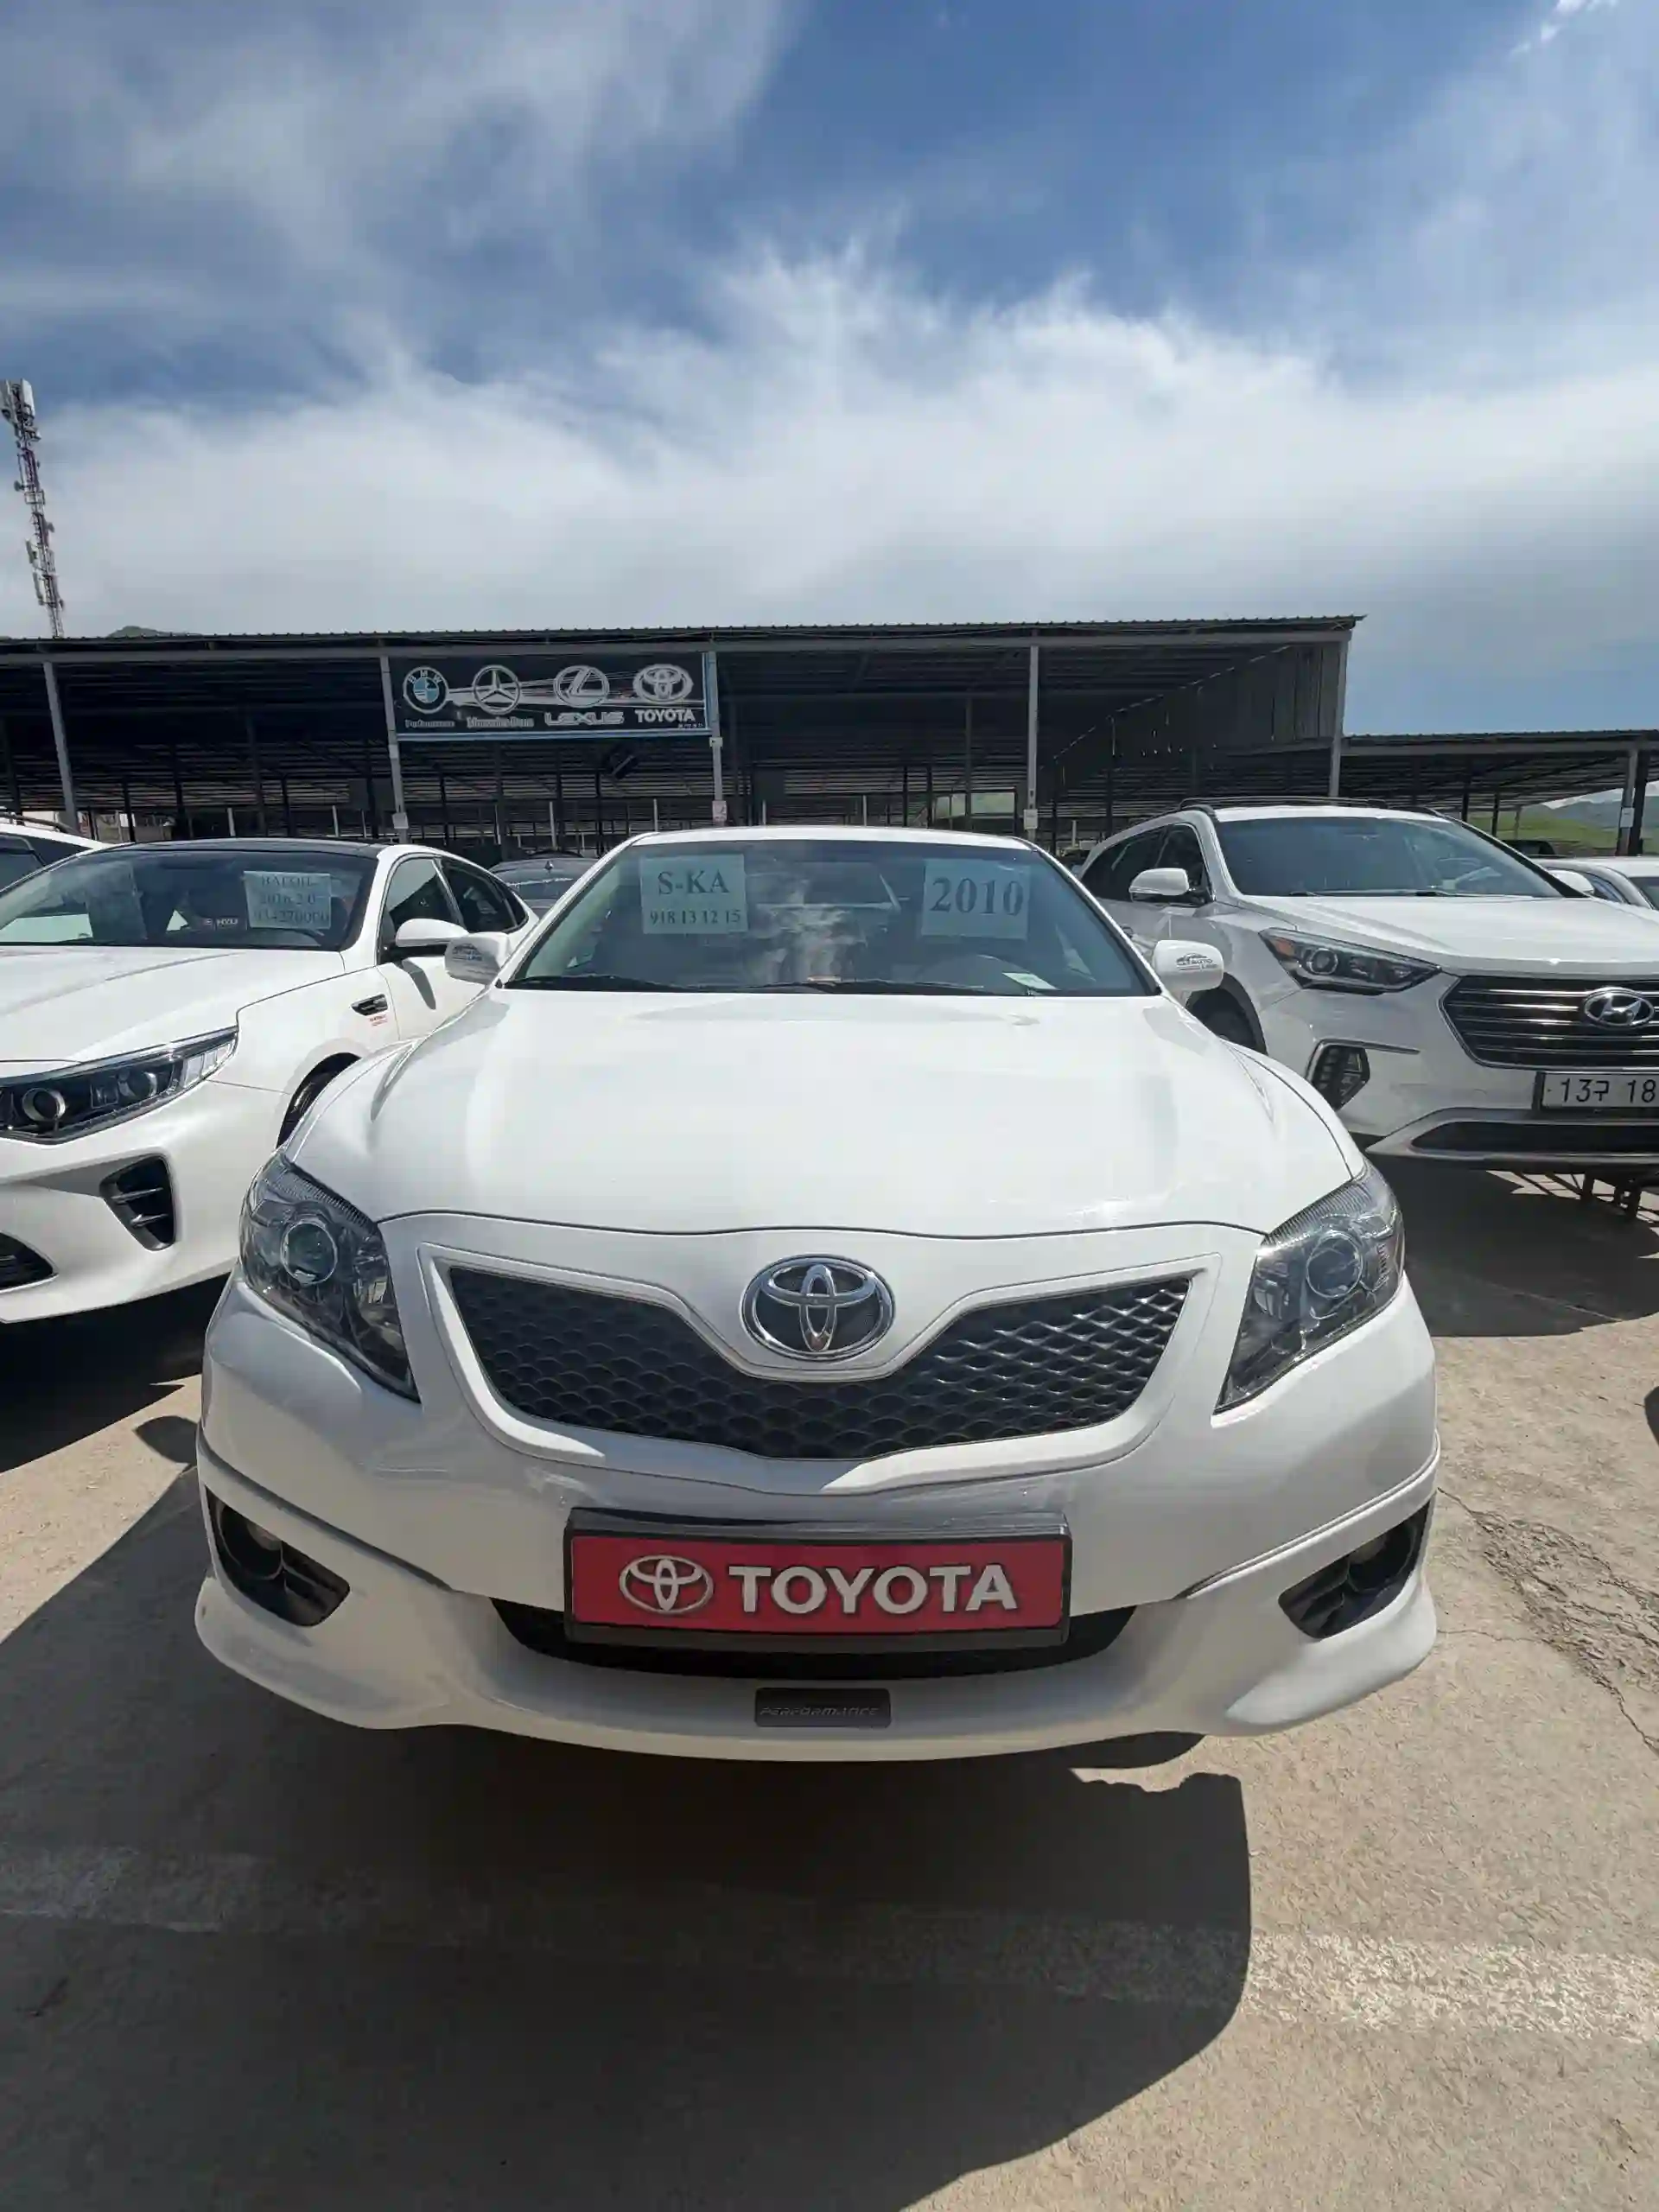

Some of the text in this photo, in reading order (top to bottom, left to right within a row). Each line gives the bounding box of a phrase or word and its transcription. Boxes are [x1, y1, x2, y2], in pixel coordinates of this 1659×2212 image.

[543, 711, 625, 727] LEXUS
[634, 709, 696, 723] TOYOTA
[658, 869, 730, 896] S-KA
[931, 876, 1025, 917] 2010
[650, 909, 741, 926] 918 13 12 15
[728, 1564, 1018, 1614] TOYOTA
